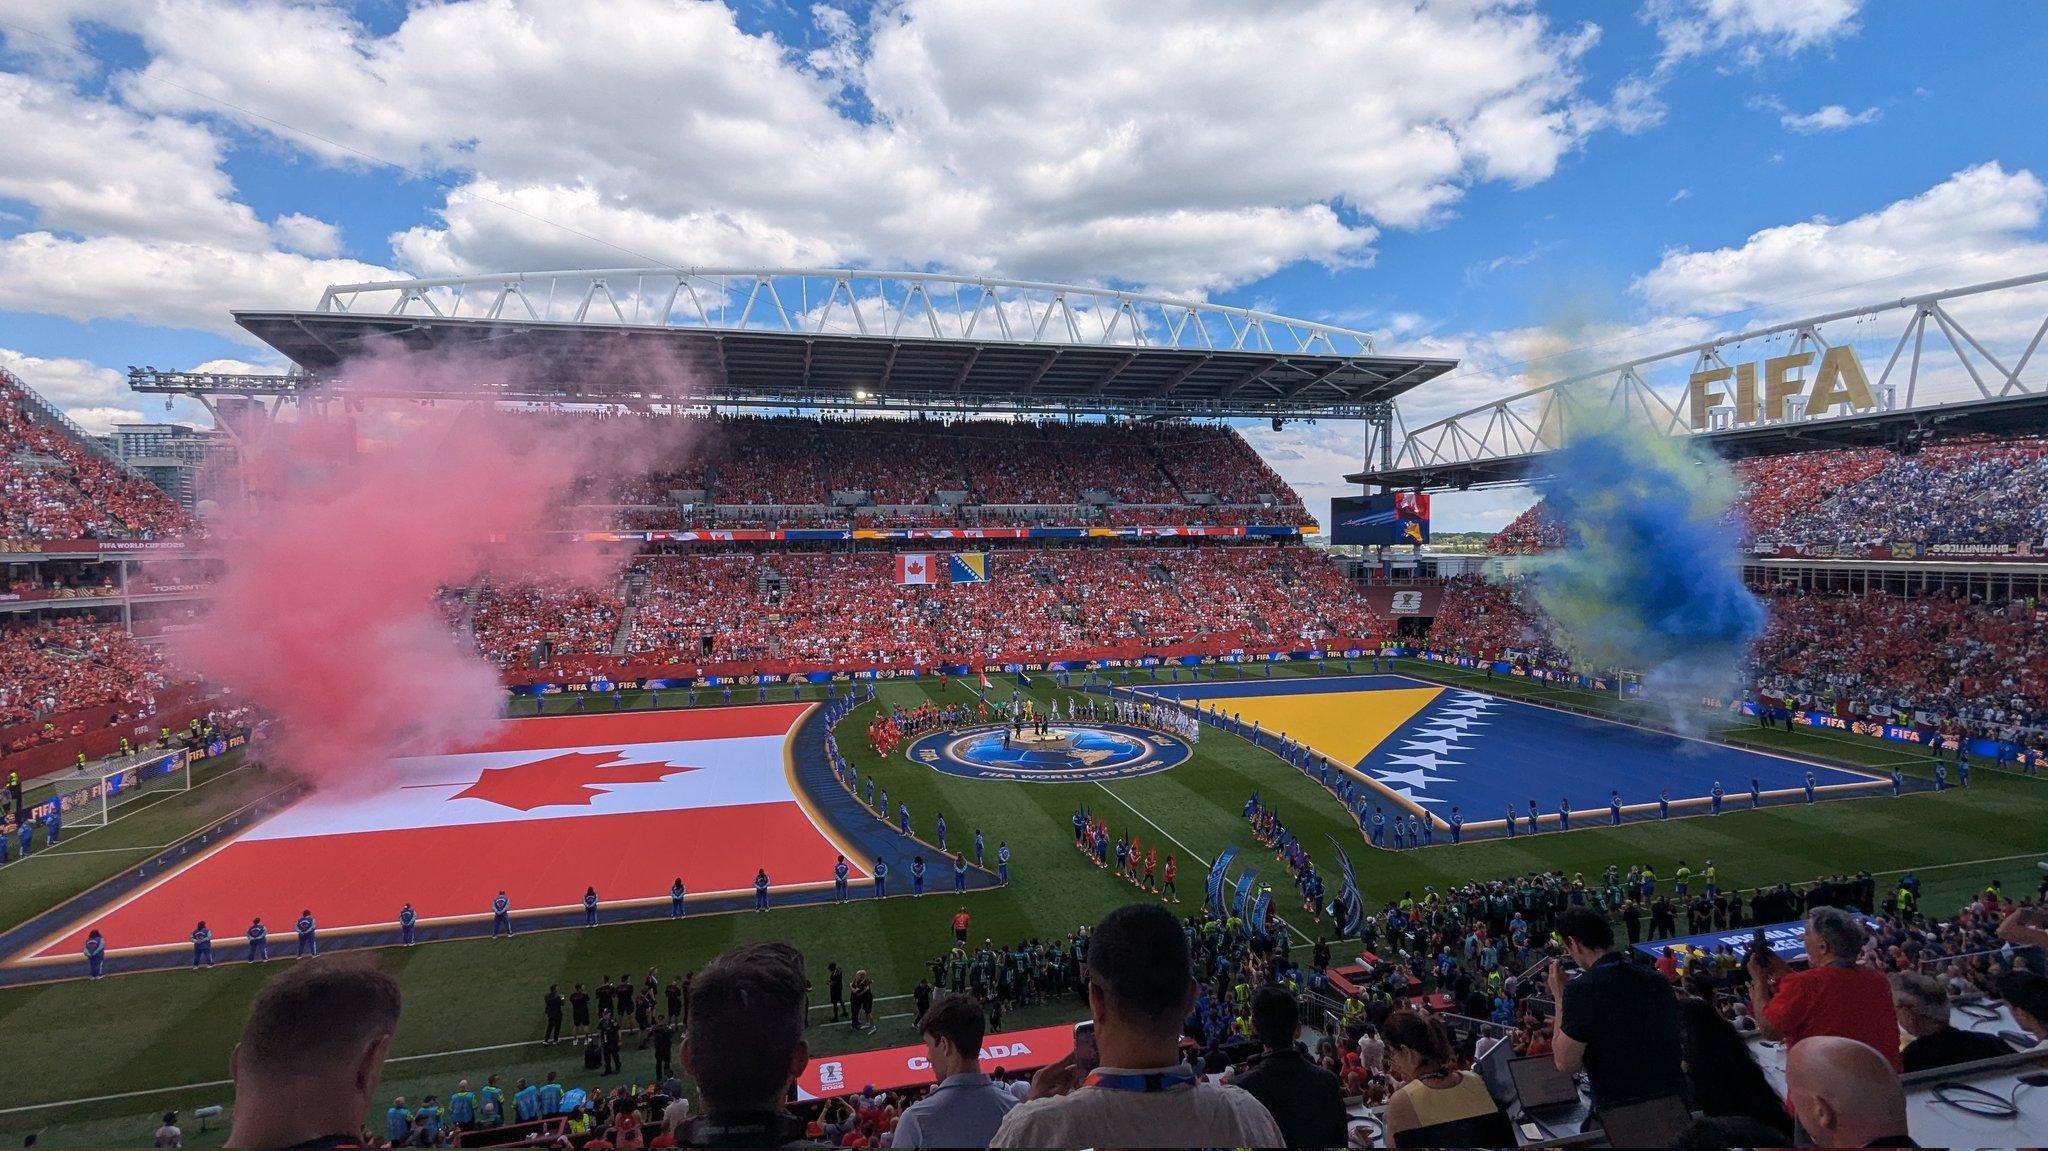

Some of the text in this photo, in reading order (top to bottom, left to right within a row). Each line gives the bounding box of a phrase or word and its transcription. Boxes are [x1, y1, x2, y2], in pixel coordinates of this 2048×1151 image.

[1690, 344, 1878, 430] FIFA
[1256, 653, 1270, 661] FIFA
[1362, 649, 1376, 657] FIFA
[985, 665, 1000, 673] FIFA
[716, 676, 734, 685] FIFA
[855, 671, 872, 679] FIFA
[618, 681, 637, 689] FIFA
[1820, 716, 1846, 729] FIFA
[134, 725, 149, 736] FIFA
[1891, 728, 1920, 742] FIFA
[230, 735, 245, 748] FIFA
[189, 748, 205, 762] FIFA
[979, 771, 1016, 779] FIFA
[31, 801, 56, 820] FIFA
[907, 1042, 1032, 1070] CADA
